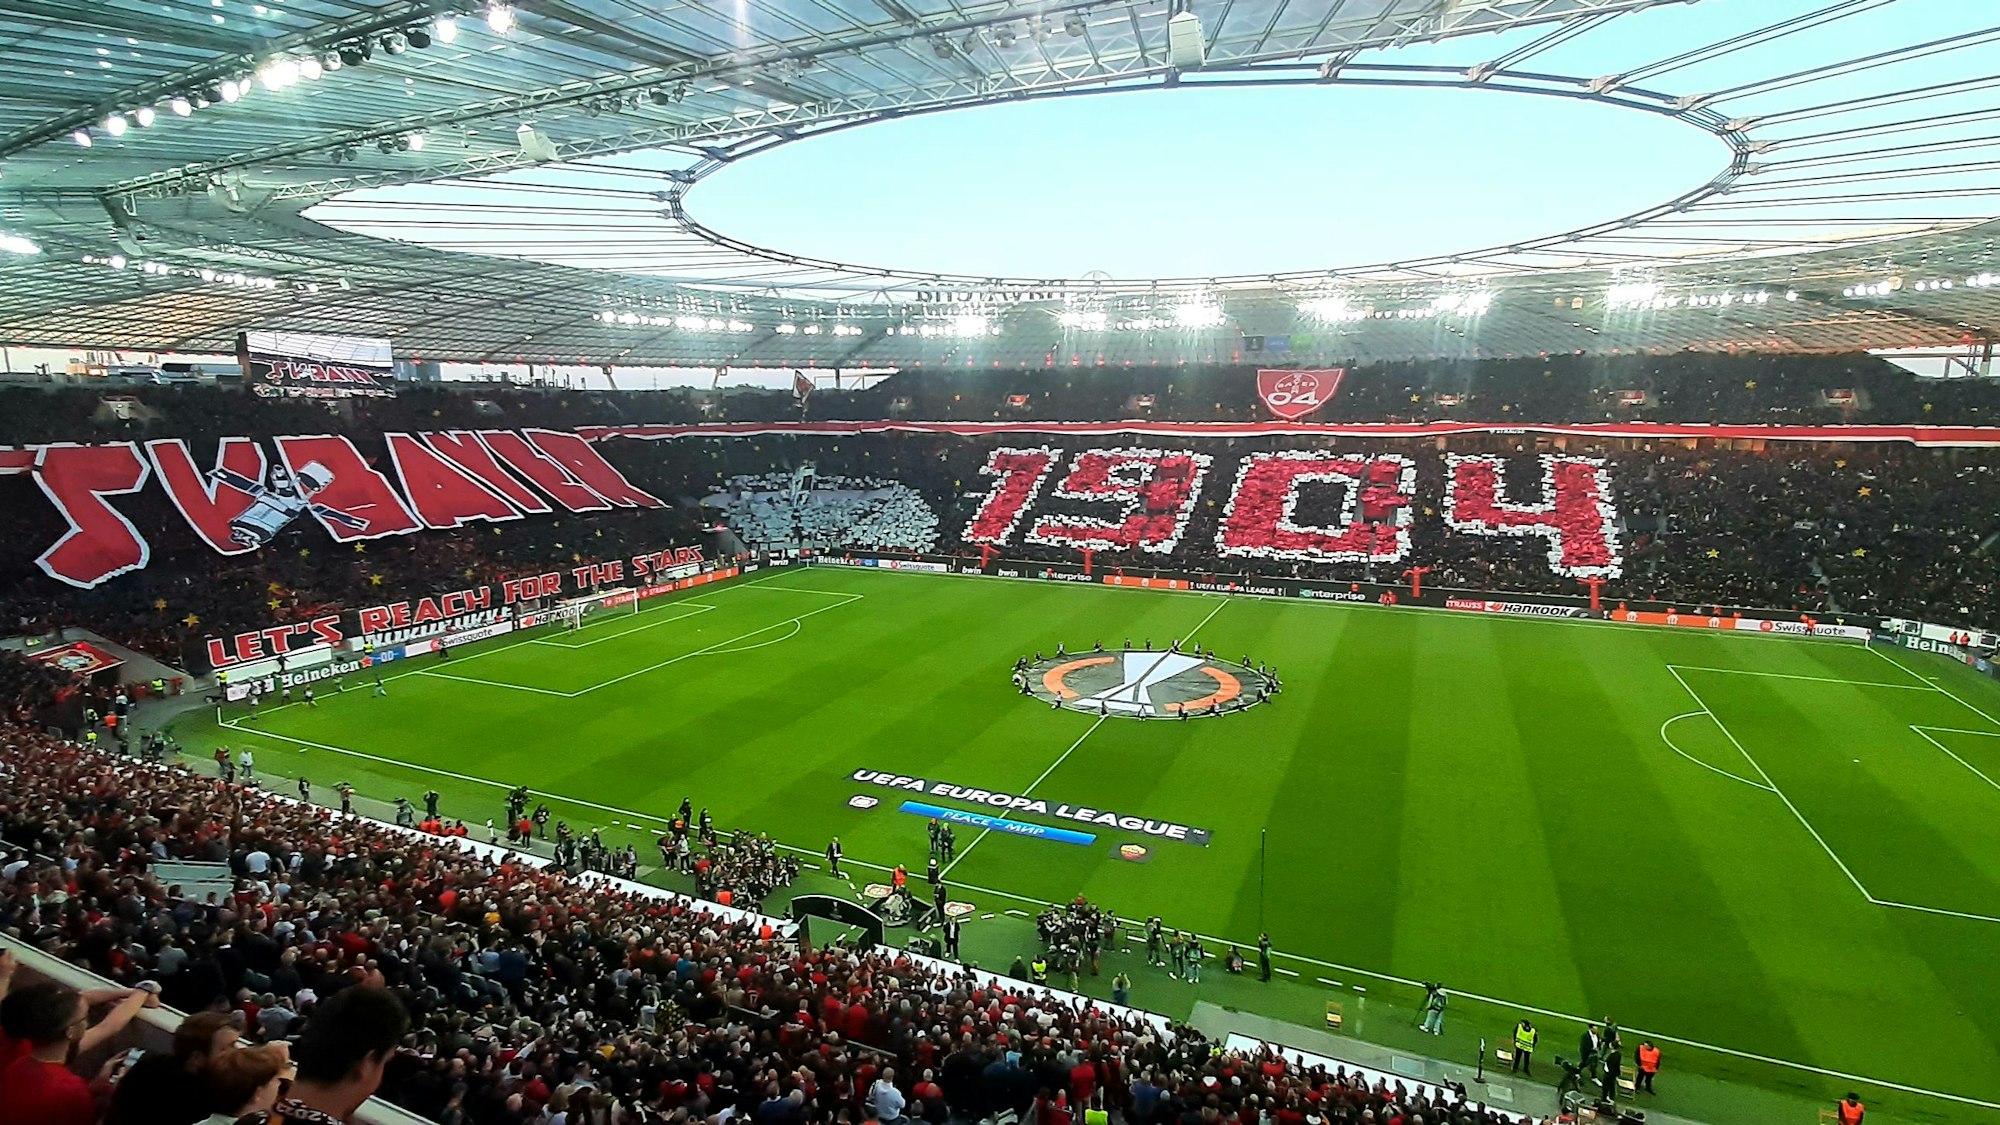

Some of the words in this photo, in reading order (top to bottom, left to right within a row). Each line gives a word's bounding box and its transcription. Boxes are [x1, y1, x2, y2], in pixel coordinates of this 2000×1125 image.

[1268, 391, 1319, 405] 04
[960, 446, 1623, 580] 1904
[962, 566, 982, 575] bwin
[998, 569, 1018, 577] bwin
[1196, 582, 1215, 590] UEFA
[1216, 584, 1244, 592] EURPA
[1246, 586, 1275, 595] LEAGUE
[1303, 588, 1366, 601] enterprise
[207, 615, 344, 668] LET'S
[359, 586, 491, 635] REACH
[503, 572, 562, 605] FOR
[573, 560, 624, 589] THE
[631, 544, 704, 577] STARS
[853, 769, 926, 792] UEFA
[930, 783, 1047, 814] EUROPA
[1055, 804, 1189, 839] LEAGUE
[943, 811, 989, 826] PEACE
